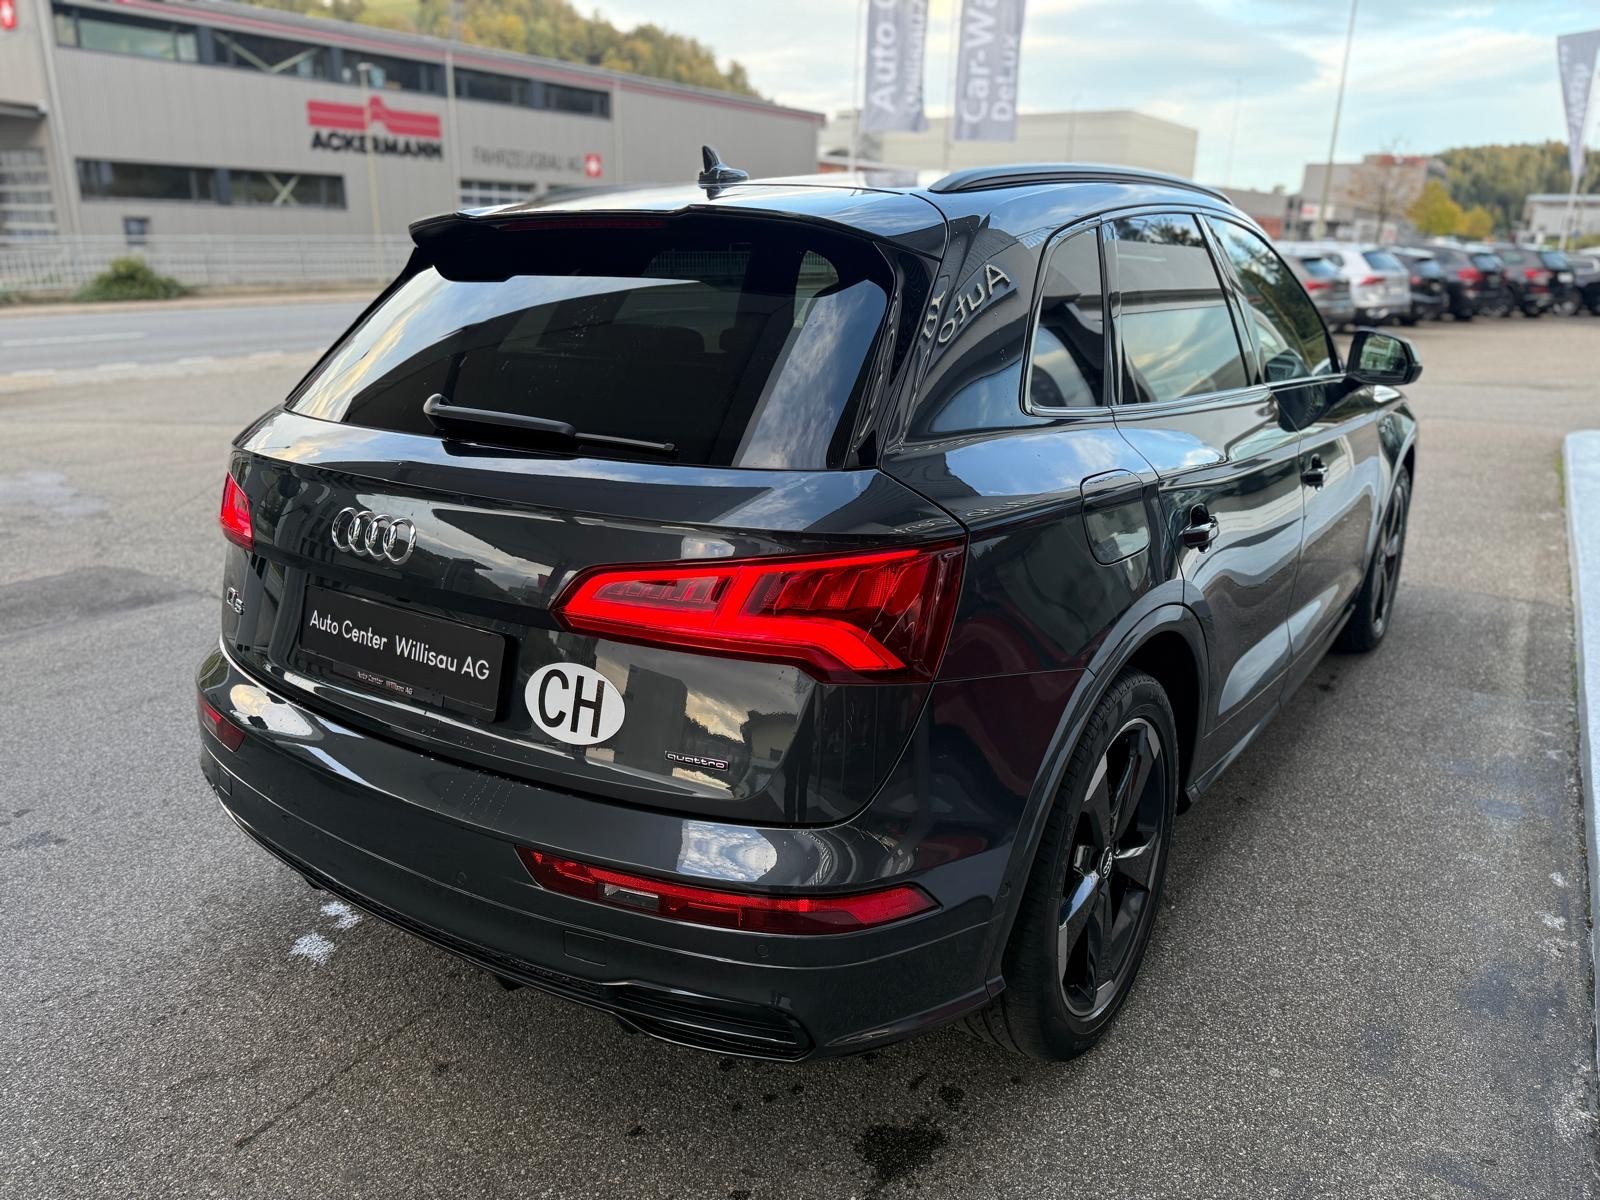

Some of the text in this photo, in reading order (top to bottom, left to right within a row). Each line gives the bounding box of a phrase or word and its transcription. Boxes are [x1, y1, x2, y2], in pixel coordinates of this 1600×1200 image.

[870, 21, 897, 113] Auto
[311, 131, 443, 159] ACKERMANN
[226, 586, 243, 614] Q5
[309, 610, 490, 680] Auto Center Willisau AG
[538, 668, 605, 738] CH
[667, 753, 725, 769] quattro
